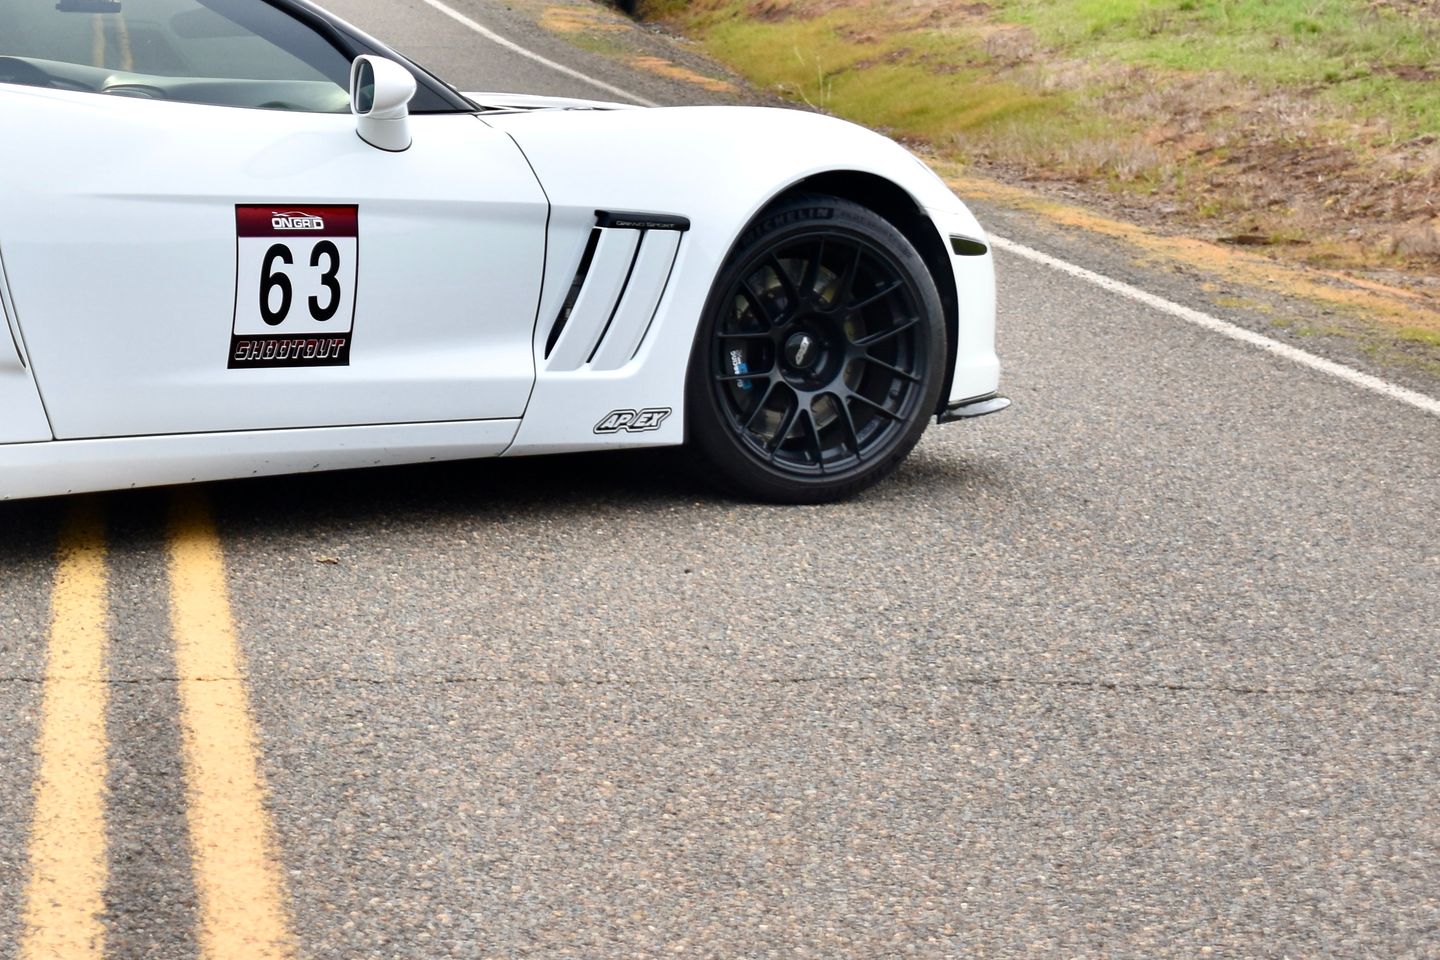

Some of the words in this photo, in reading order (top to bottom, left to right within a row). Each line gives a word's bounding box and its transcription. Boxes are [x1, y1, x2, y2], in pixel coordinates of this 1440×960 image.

[271, 217, 324, 229] ONGRID
[234, 339, 346, 361] SHOOTOUT
[596, 410, 669, 431] APEX
